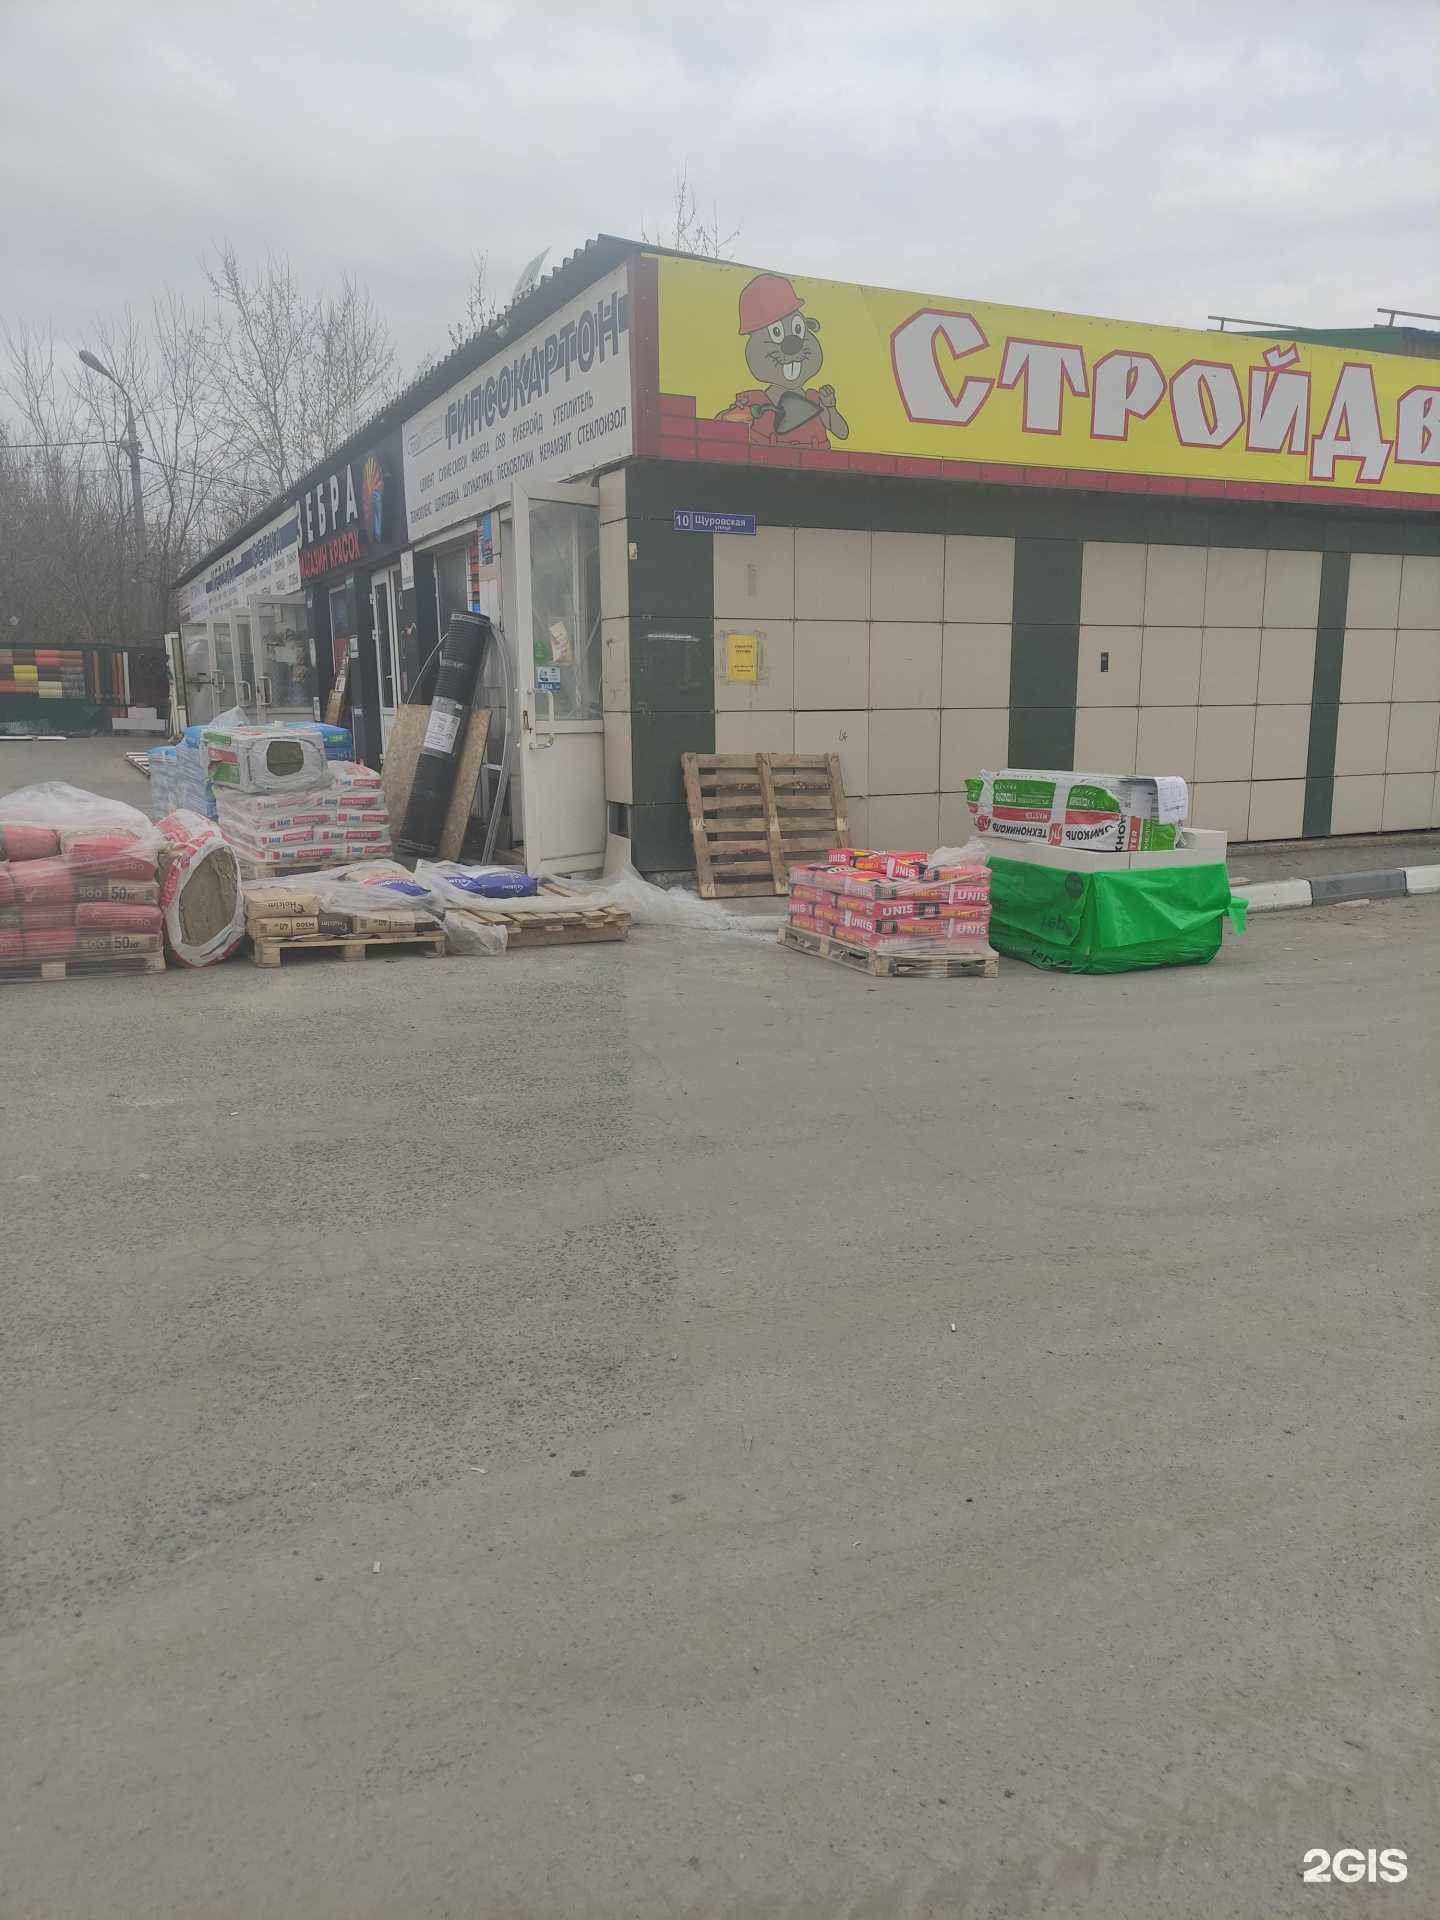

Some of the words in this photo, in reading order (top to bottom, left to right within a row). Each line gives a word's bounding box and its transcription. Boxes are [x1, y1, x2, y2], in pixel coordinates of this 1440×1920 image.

[446, 291, 619, 450] ГИПСОКАРТОН
[512, 413, 544, 444] РУБЕРОЙД
[552, 391, 594, 426] УТЕПЛИТЕЛЬ
[539, 431, 572, 462] КЕРАМЗИТ
[577, 406, 627, 446] СТЕКЛОИЗОЛ
[675, 514, 689, 527] 10
[695, 514, 746, 528] Щуровская
[330, 528, 360, 568] КРАСОК
[992, 822, 1047, 839] ТЕХНОНИКОЛЬ
[957, 889, 989, 901] UNIS
[266, 900, 297, 911] Holcim
[882, 904, 914, 917] UNIS
[851, 913, 874, 931] UNIS
[957, 923, 987, 935] UNIS
